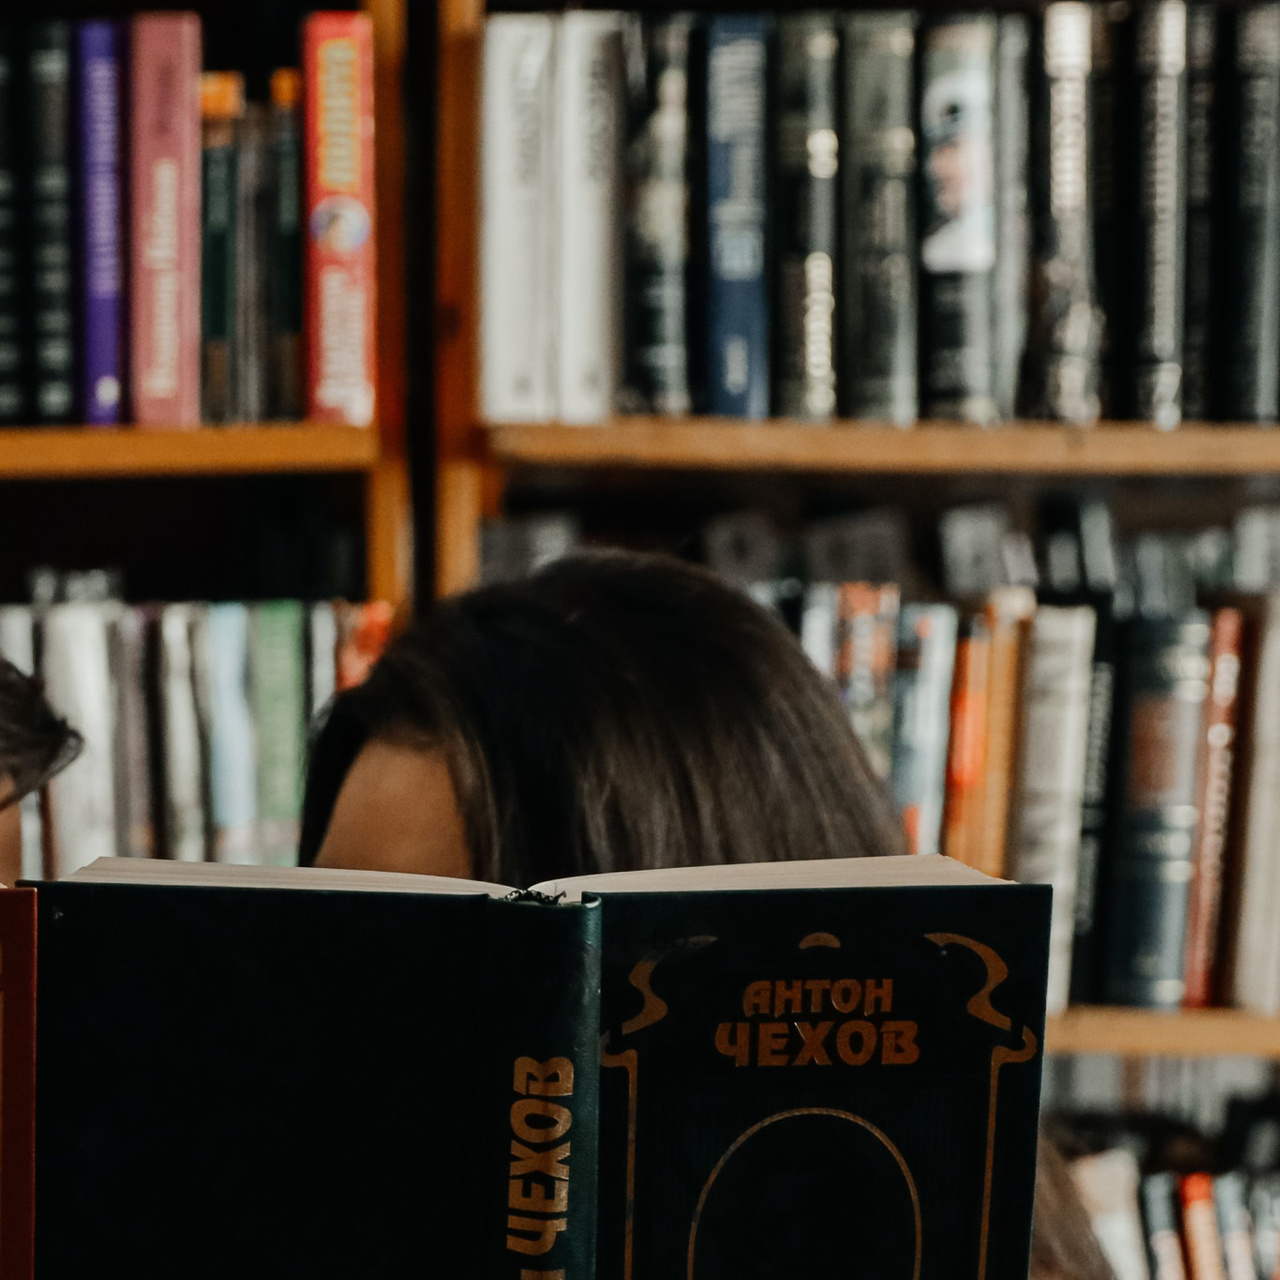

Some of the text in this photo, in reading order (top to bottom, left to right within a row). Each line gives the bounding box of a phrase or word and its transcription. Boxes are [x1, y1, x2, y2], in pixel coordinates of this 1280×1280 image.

[742, 978, 894, 1018] АНТОН
[714, 1020, 921, 1068] ЧЕХОВ
[505, 1055, 576, 1257] ЧЕХОВ
